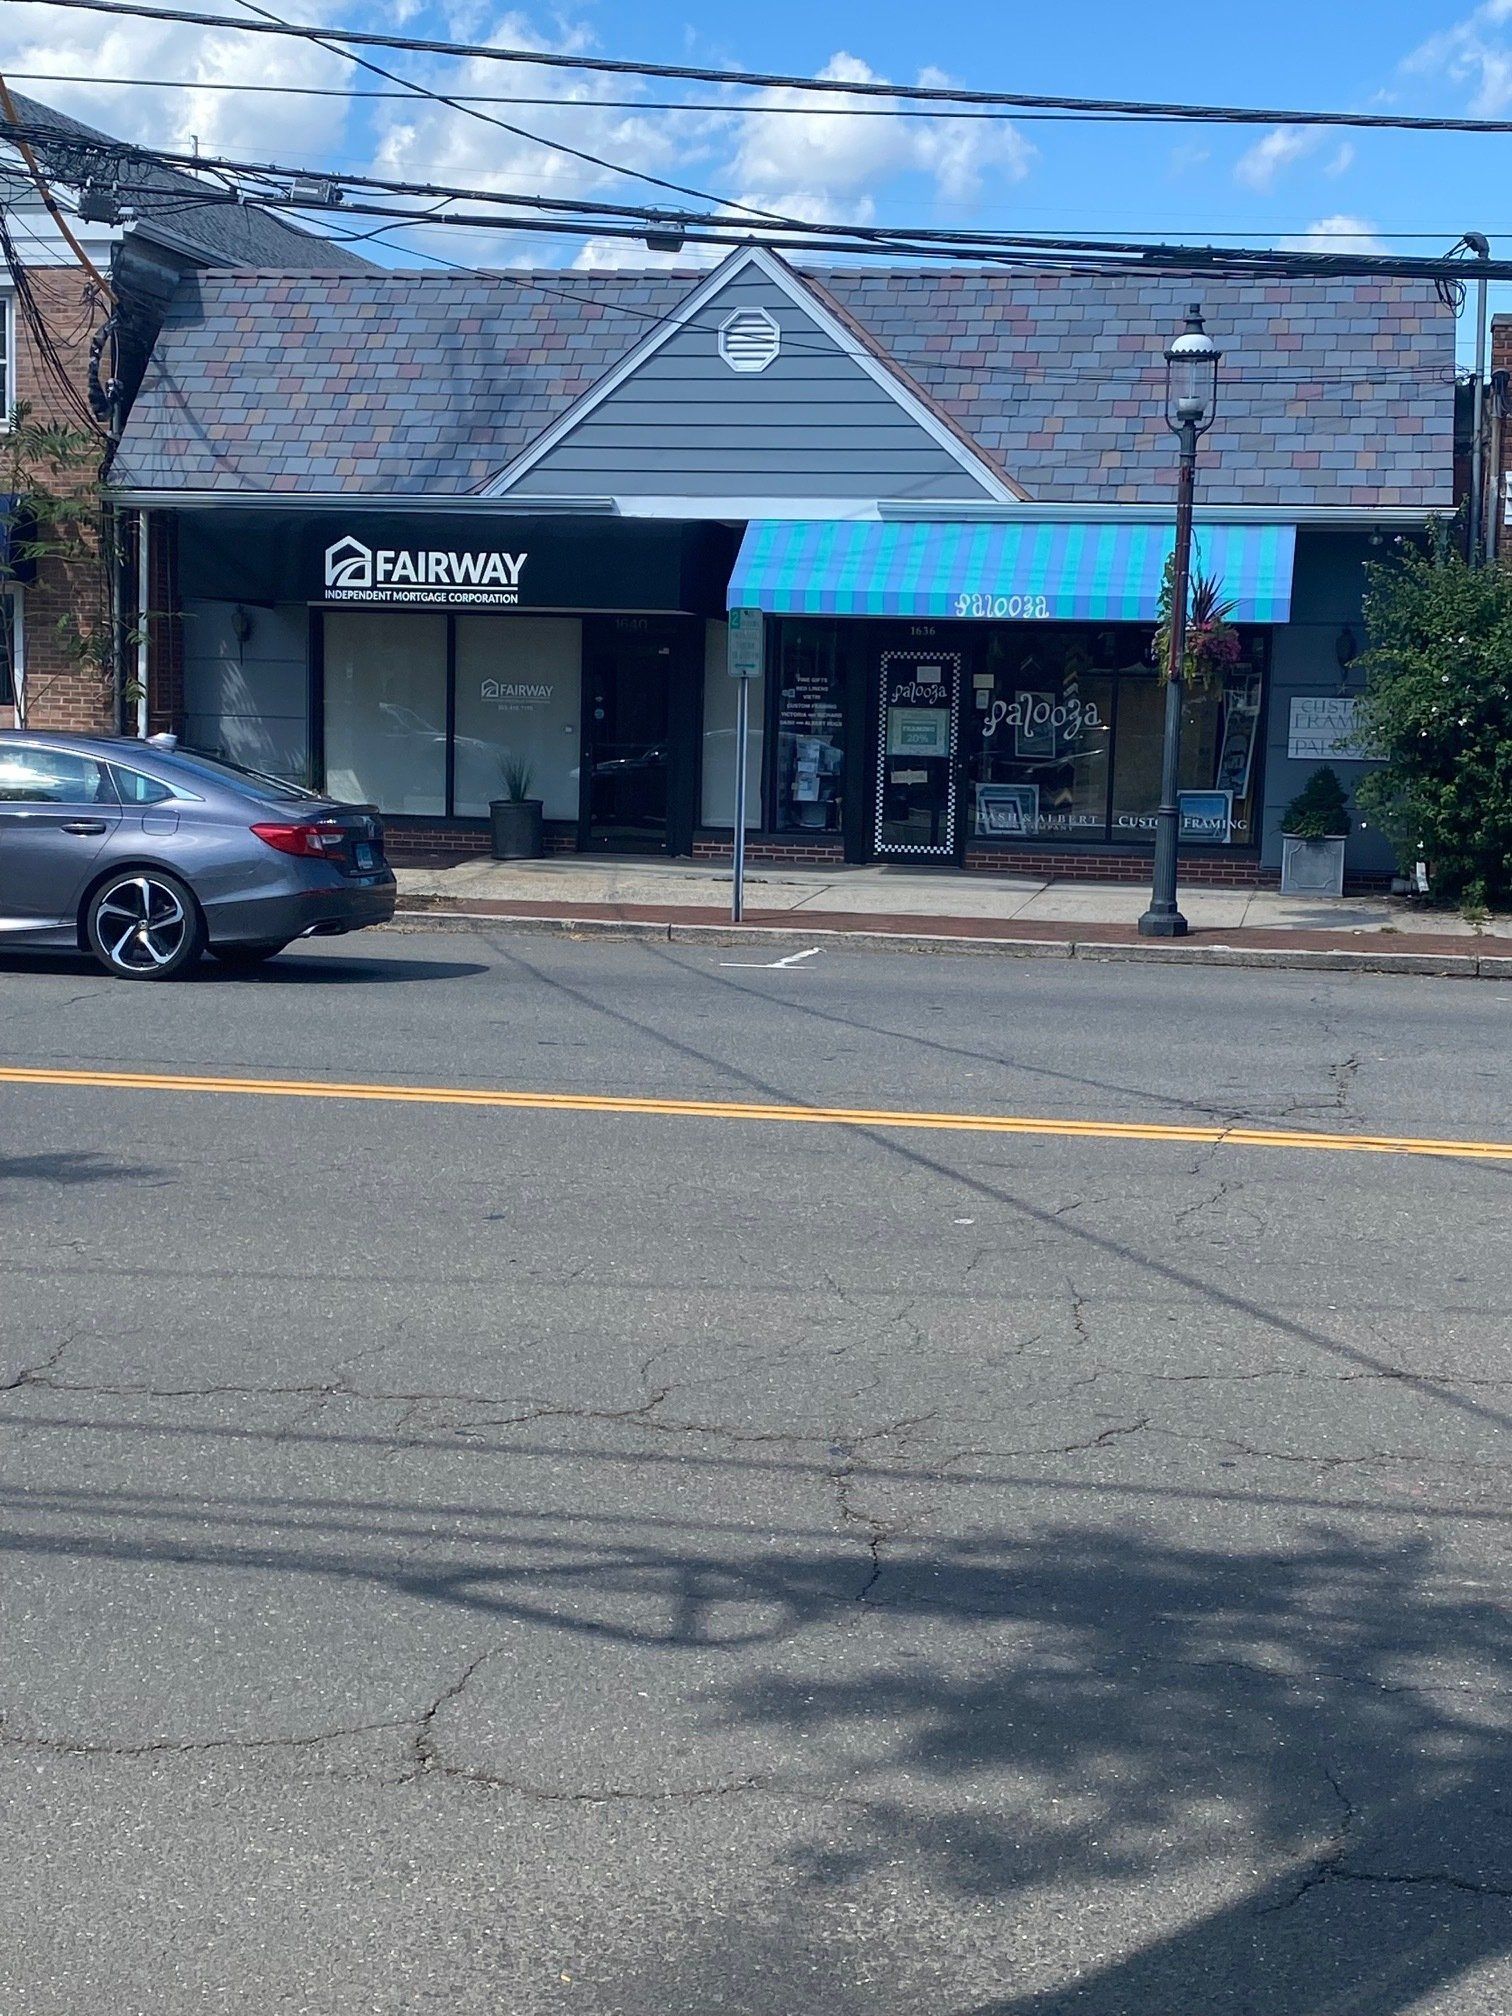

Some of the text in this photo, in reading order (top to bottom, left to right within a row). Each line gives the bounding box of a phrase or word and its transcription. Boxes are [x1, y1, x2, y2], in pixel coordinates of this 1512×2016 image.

[376, 550, 528, 585] FAIRWAY
[324, 589, 518, 604] INDEPENDENT MORTGAGE CORPORATION
[910, 625, 936, 636] 1636
[500, 684, 553, 697] FAIRWAY
[891, 681, 948, 704] palooza
[1301, 700, 1353, 714] CUST
[982, 693, 1102, 740] palooza
[1038, 814, 1098, 825] ALBERT
[1118, 816, 1248, 830] CUST FRAMING
